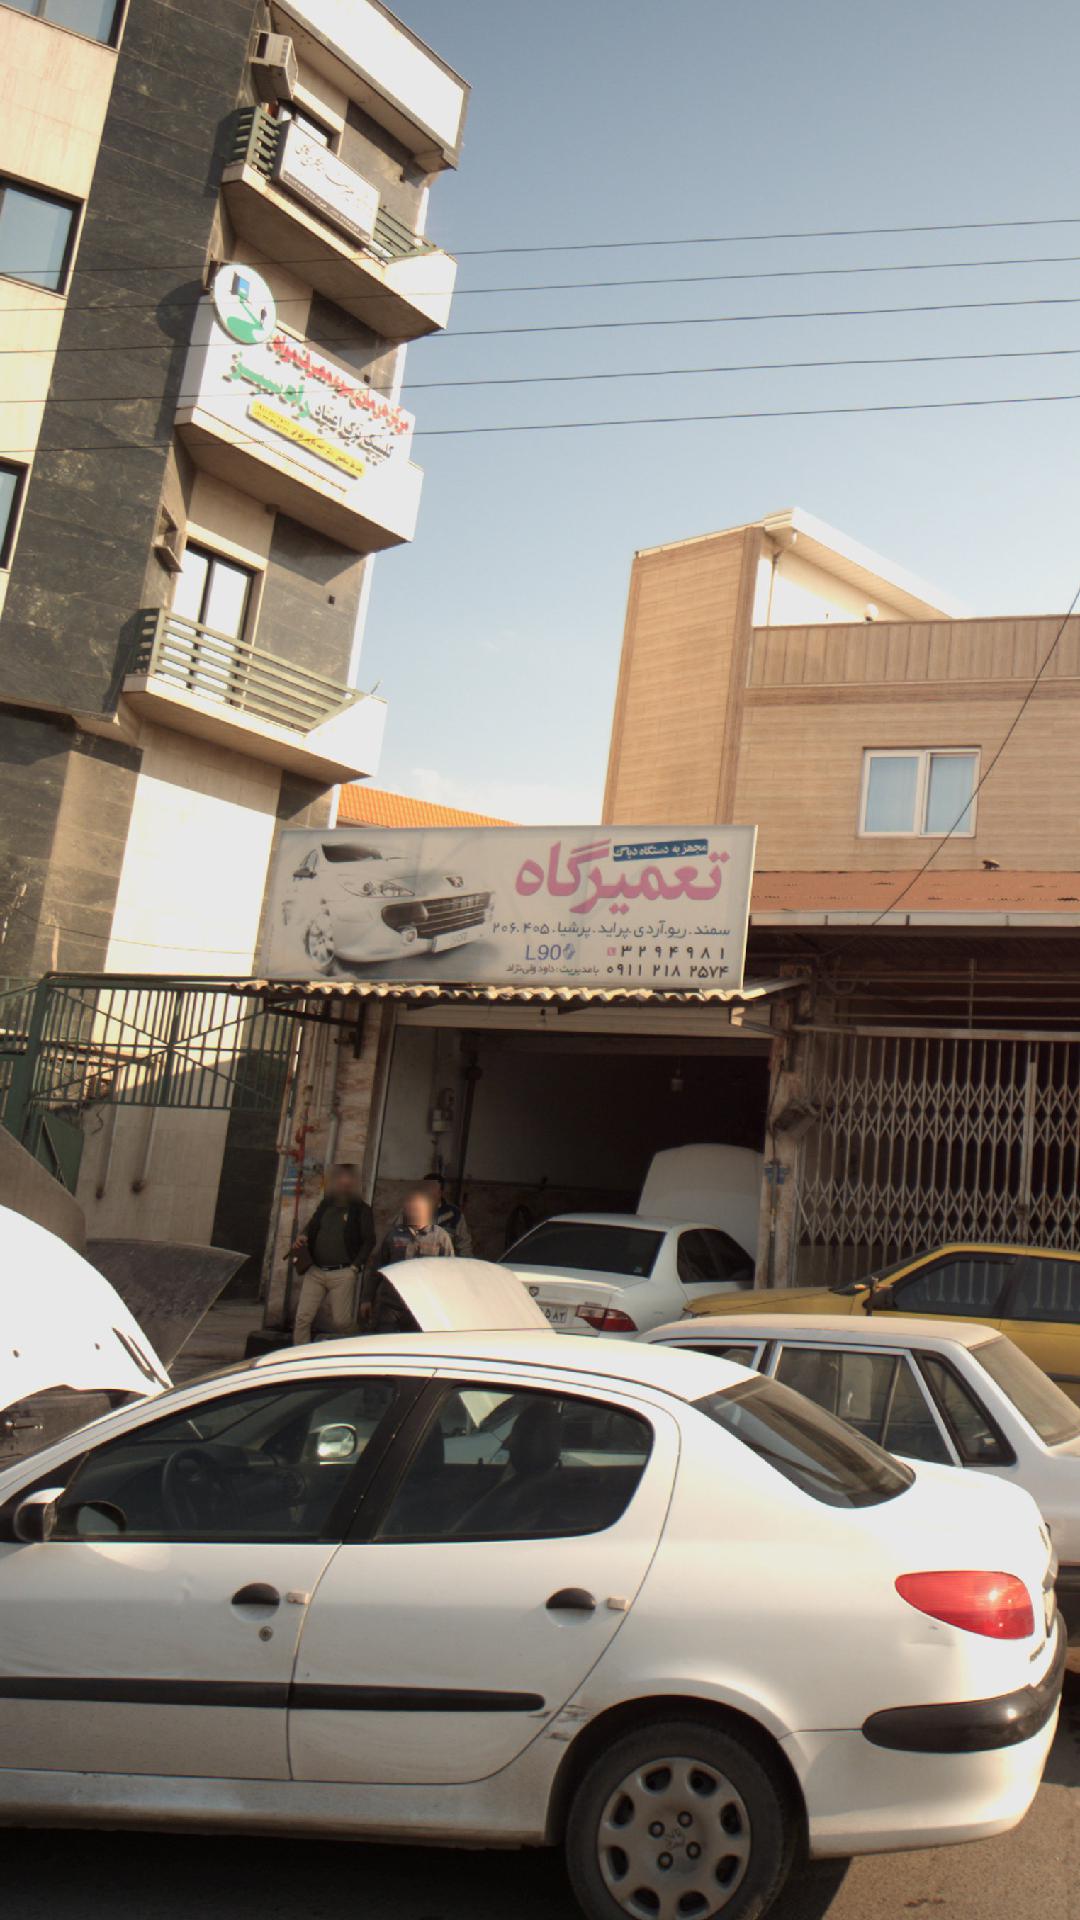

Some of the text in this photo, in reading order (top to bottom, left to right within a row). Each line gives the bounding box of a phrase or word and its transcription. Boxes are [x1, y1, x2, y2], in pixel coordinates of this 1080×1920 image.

[315, 405, 343, 431] اعتیاد
[344, 422, 364, 443] ترک
[363, 434, 394, 462] کلینیک
[639, 845, 669, 856] دستگاه
[672, 845, 679, 856] به
[680, 843, 704, 855] مجهز
[514, 838, 730, 914] تعمیرگاه
[493, 922, 516, 935] ۲۰۶
[523, 922, 550, 935] ۴۰۵
[557, 921, 592, 939] پرشیا
[598, 922, 629, 939] پراید
[694, 924, 730, 935] سمند
[525, 943, 562, 961] L90
[606, 963, 729, 979] ۰۹۱۱ ۲۱۸ ۲۵۷۴
